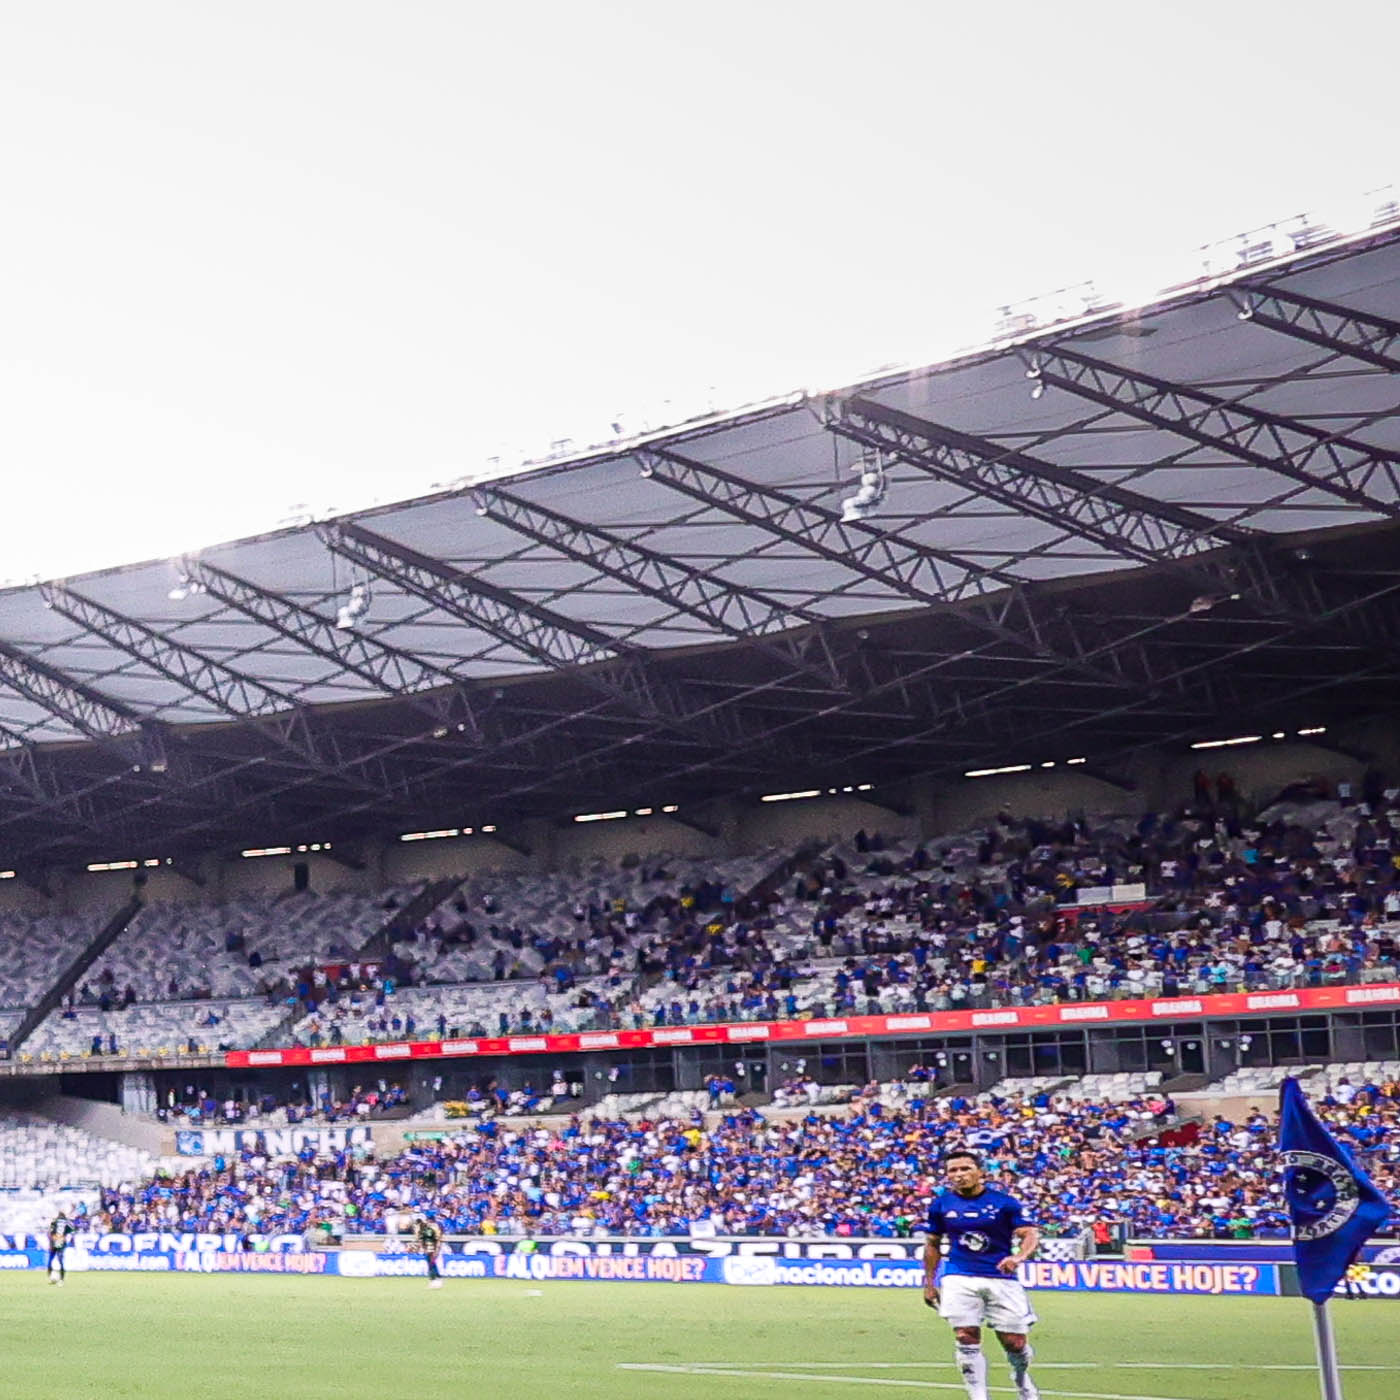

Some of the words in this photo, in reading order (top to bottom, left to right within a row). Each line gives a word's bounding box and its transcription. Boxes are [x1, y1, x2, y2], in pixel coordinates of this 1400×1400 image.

[589, 1257, 645, 1280] VENCE
[647, 1257, 707, 1282] HOJE?
[1017, 1263, 1075, 1288] UEM
[1080, 1264, 1169, 1290] VENCE
[1173, 1265, 1258, 1293] HOJE?
